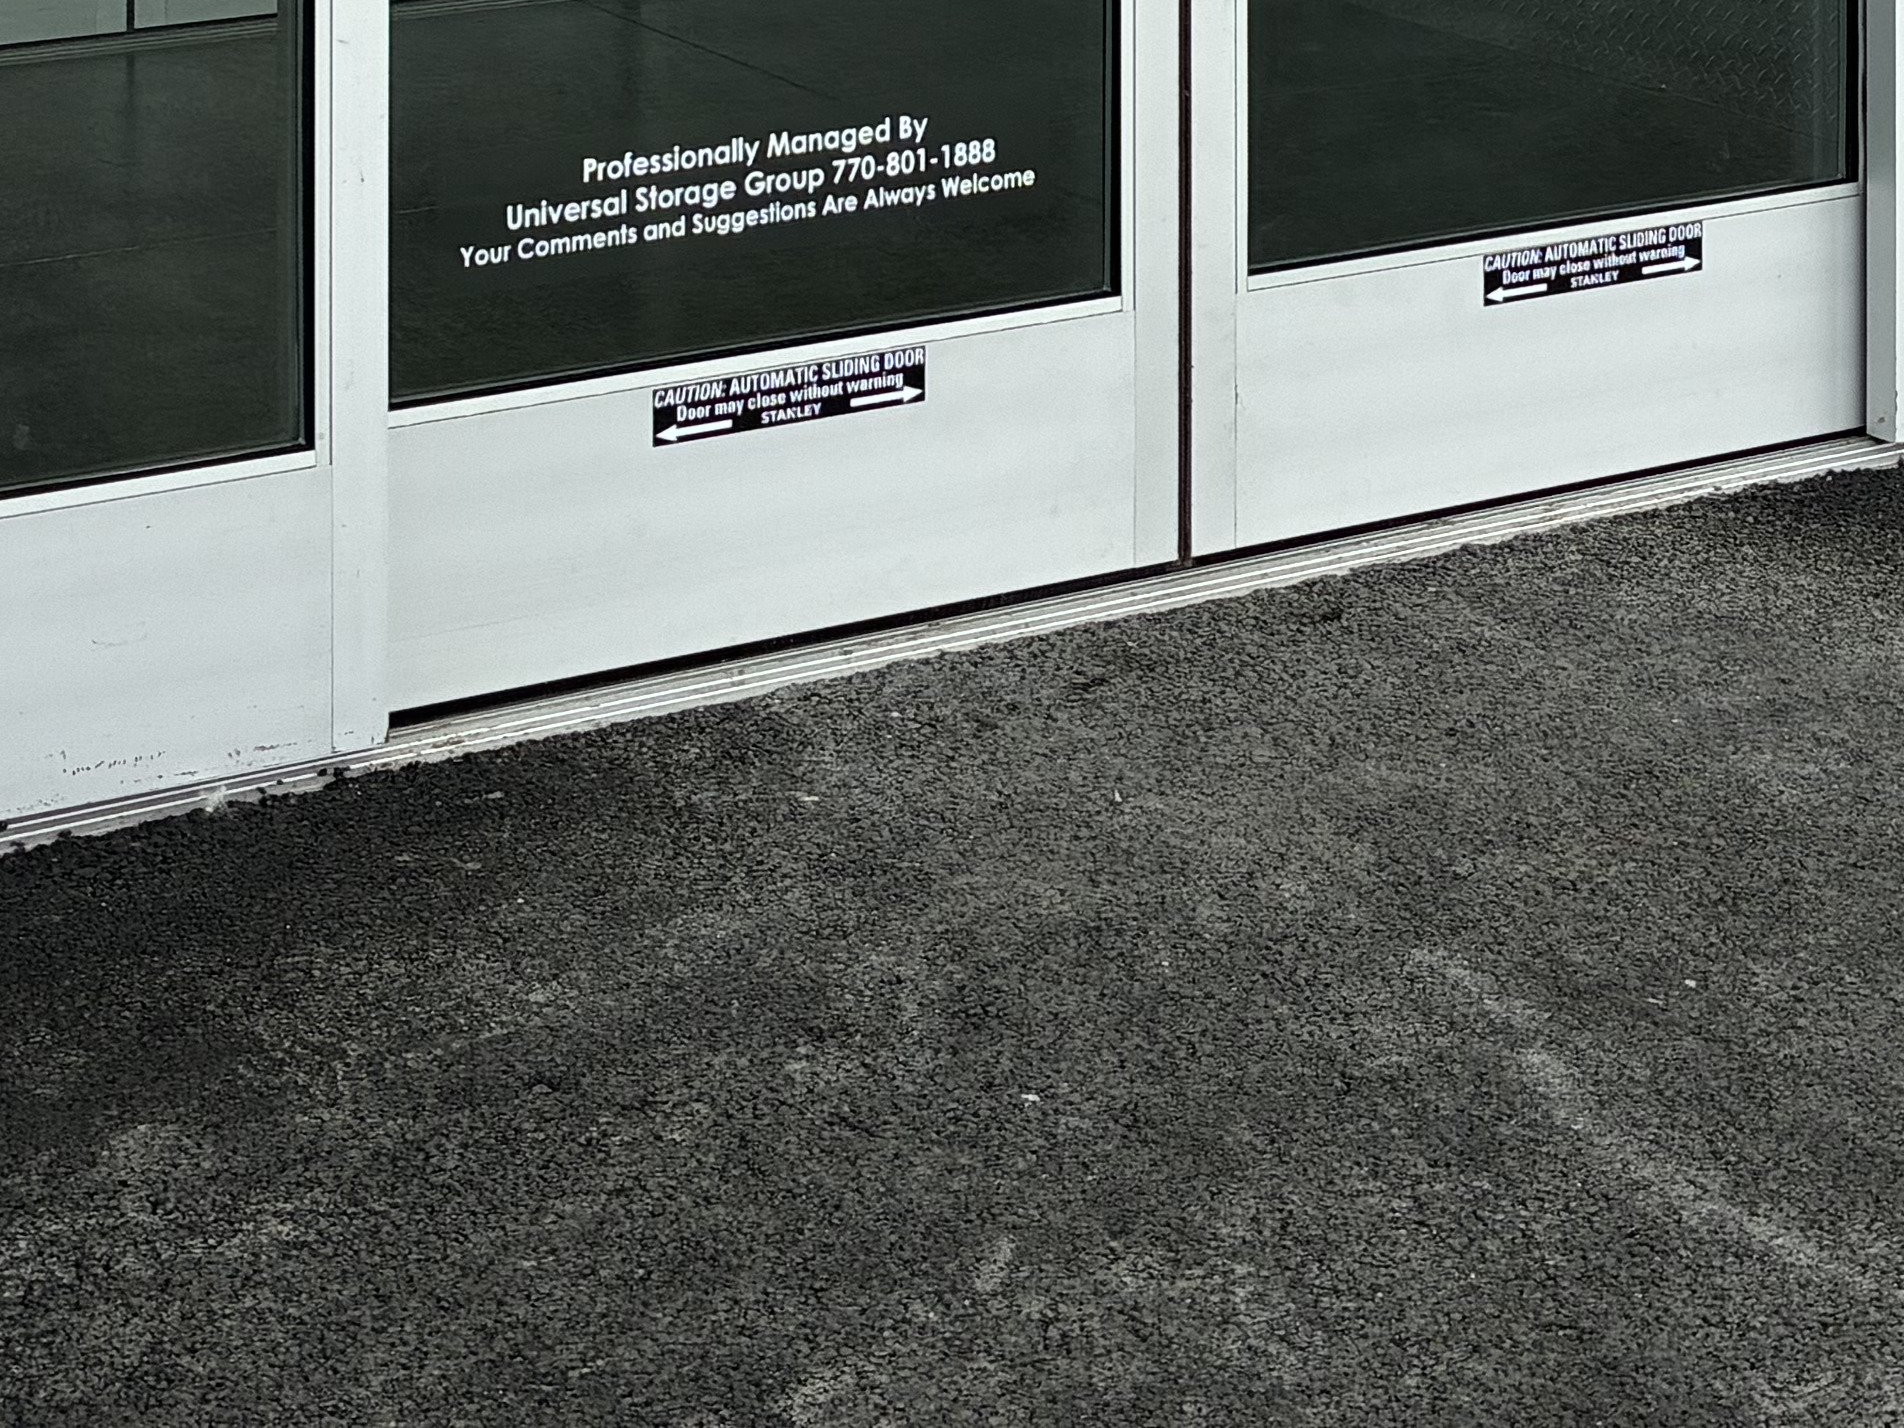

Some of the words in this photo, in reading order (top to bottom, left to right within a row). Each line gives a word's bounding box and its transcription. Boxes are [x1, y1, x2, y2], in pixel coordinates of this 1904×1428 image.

[582, 137, 761, 184] Professionally
[767, 118, 891, 159] Managed
[898, 115, 929, 143] By
[506, 189, 627, 232] Universal
[635, 180, 736, 214] Storage
[745, 166, 824, 197] Group
[832, 138, 996, 185] 770-801-1888
[460, 243, 511, 269] Your
[517, 226, 637, 260] Comments
[643, 216, 686, 242] and
[692, 200, 816, 237] Suggestions
[822, 195, 858, 218] Are
[864, 183, 936, 210] Always
[941, 168, 1036, 199] Welcome
[1484, 249, 1542, 273] CAUTION:
[1544, 237, 1617, 262] AUTOMATIC
[1619, 228, 1667, 251] SLIDING
[1668, 222, 1702, 242] DOOR
[1502, 267, 1530, 285] Door
[1532, 264, 1557, 281] may
[1559, 257, 1591, 276] close
[1593, 248, 1637, 270] without
[1639, 244, 1686, 264] warning
[1570, 270, 1620, 288] STANLEY
[654, 383, 727, 409] CAUTION:
[729, 365, 818, 395] AUTOMATIC
[821, 353, 880, 381] SLIDING
[883, 347, 925, 370] DOOR
[676, 403, 712, 423] Door
[714, 400, 745, 417] may
[747, 391, 786, 410] close
[789, 380, 843, 403] without
[846, 371, 904, 395] warning
[760, 402, 822, 425] STANLEY
